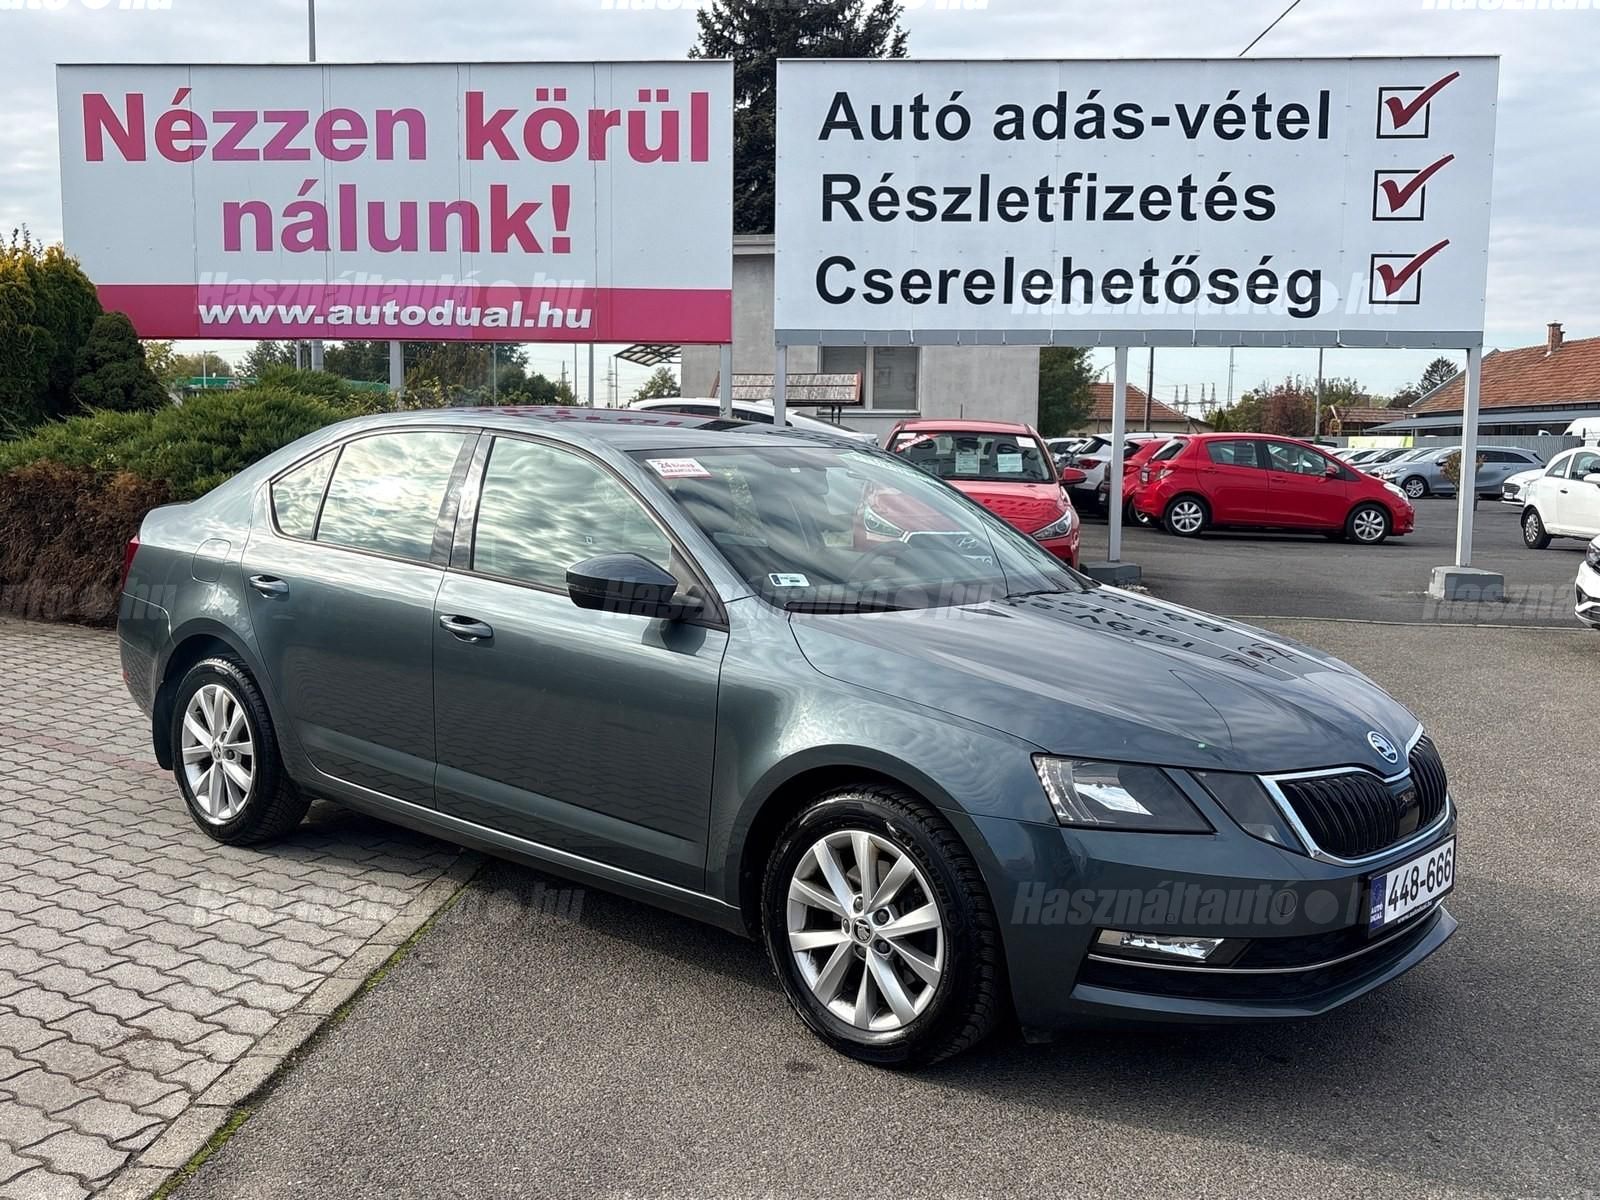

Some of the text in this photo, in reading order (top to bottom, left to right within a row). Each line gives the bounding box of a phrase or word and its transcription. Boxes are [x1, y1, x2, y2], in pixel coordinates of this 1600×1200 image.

[83, 88, 709, 162] Nézzen körül
[818, 90, 1330, 141] Autó adás-vétel
[223, 179, 571, 254] nálunk!
[821, 172, 1276, 223] Részletfizetés
[198, 299, 593, 330] www.autodual.hu
[816, 255, 1321, 318] Cserelehetőség
[1388, 847, 1452, 912] 448-666
